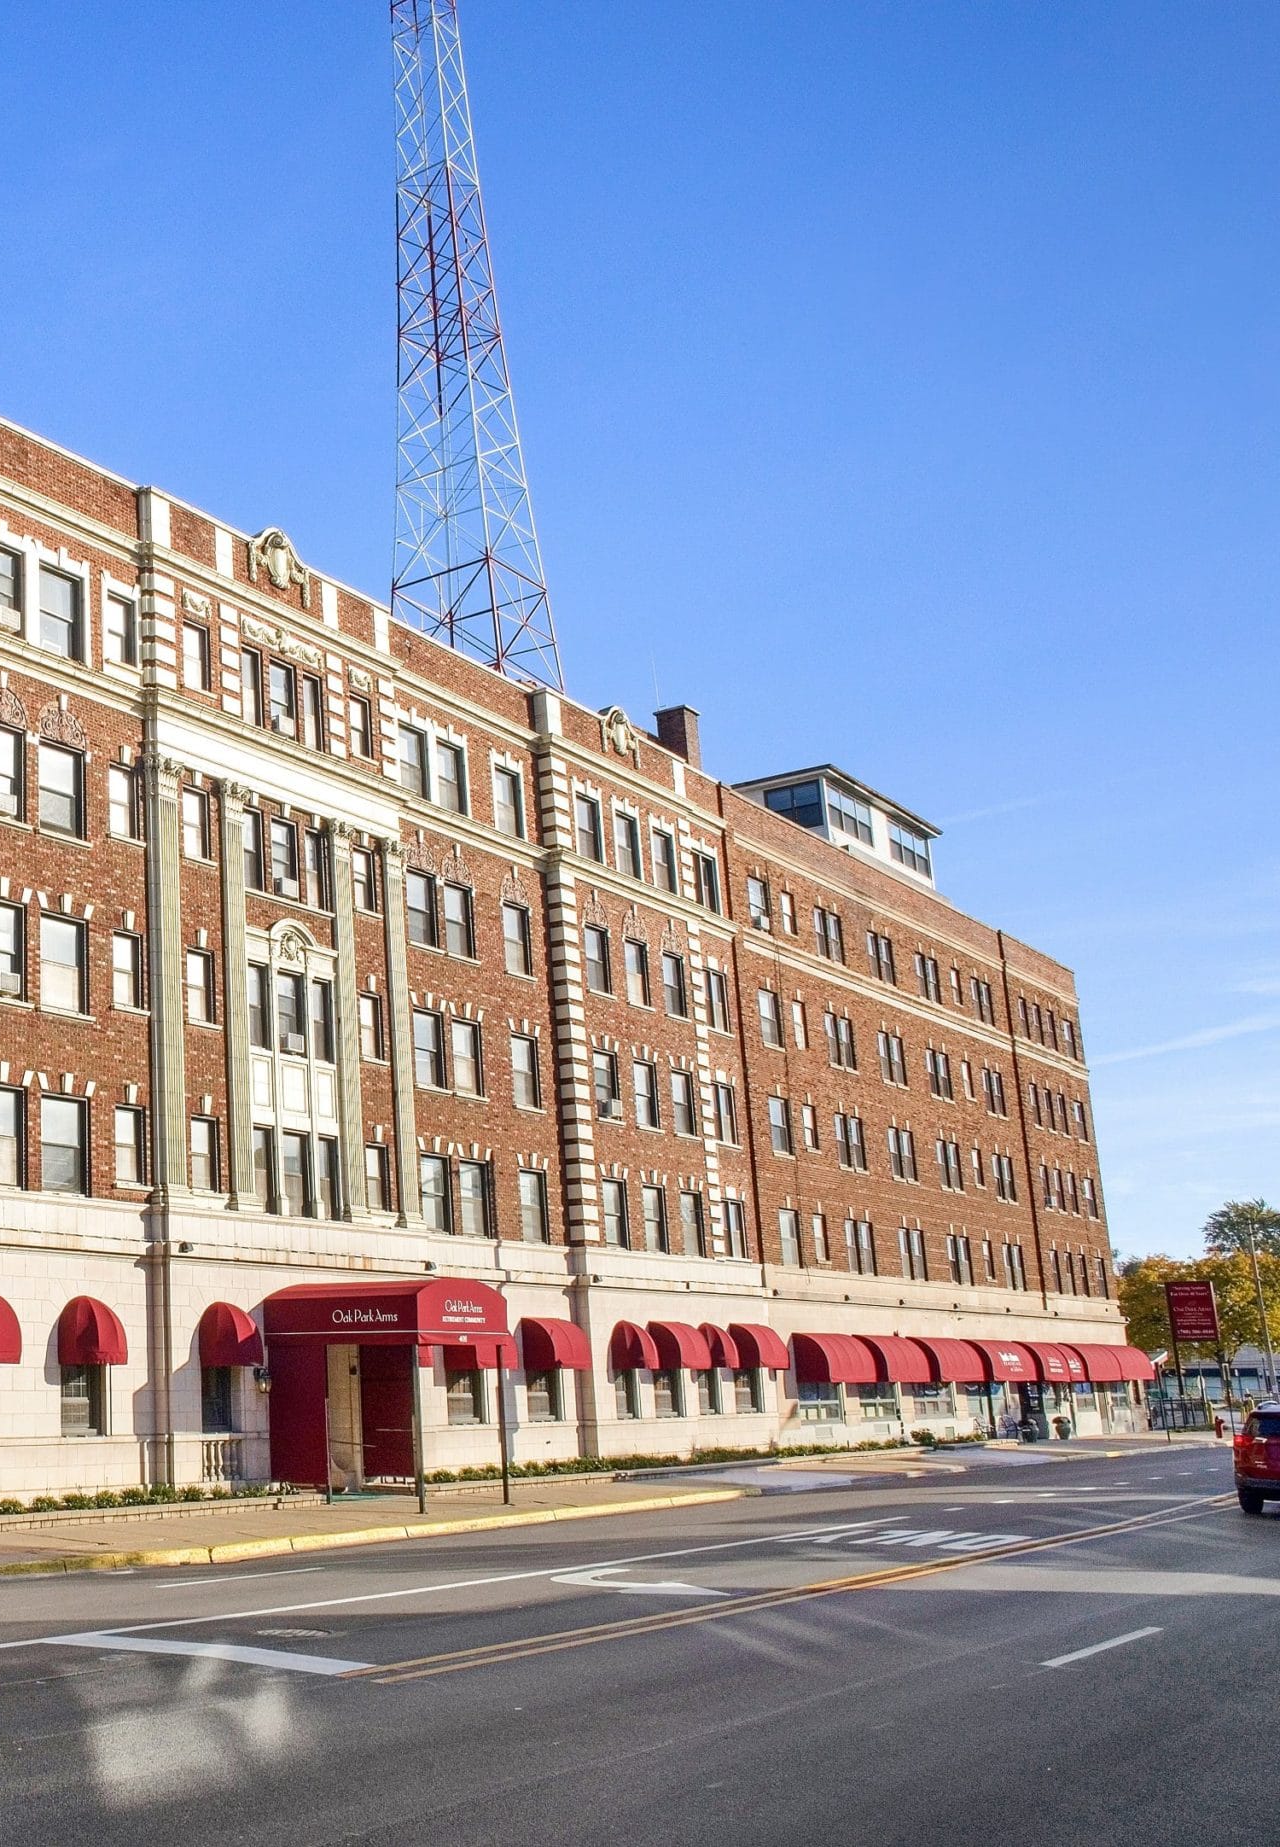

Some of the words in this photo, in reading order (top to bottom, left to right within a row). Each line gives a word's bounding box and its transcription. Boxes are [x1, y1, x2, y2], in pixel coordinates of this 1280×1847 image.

[444, 1299, 457, 1312] Oak
[458, 1300, 471, 1313] Park
[470, 1300, 483, 1313] Arms
[332, 1309, 353, 1323] Oak
[354, 1309, 374, 1322] Park
[375, 1308, 398, 1322] Arms
[773, 1529, 1034, 1550] ONLY
